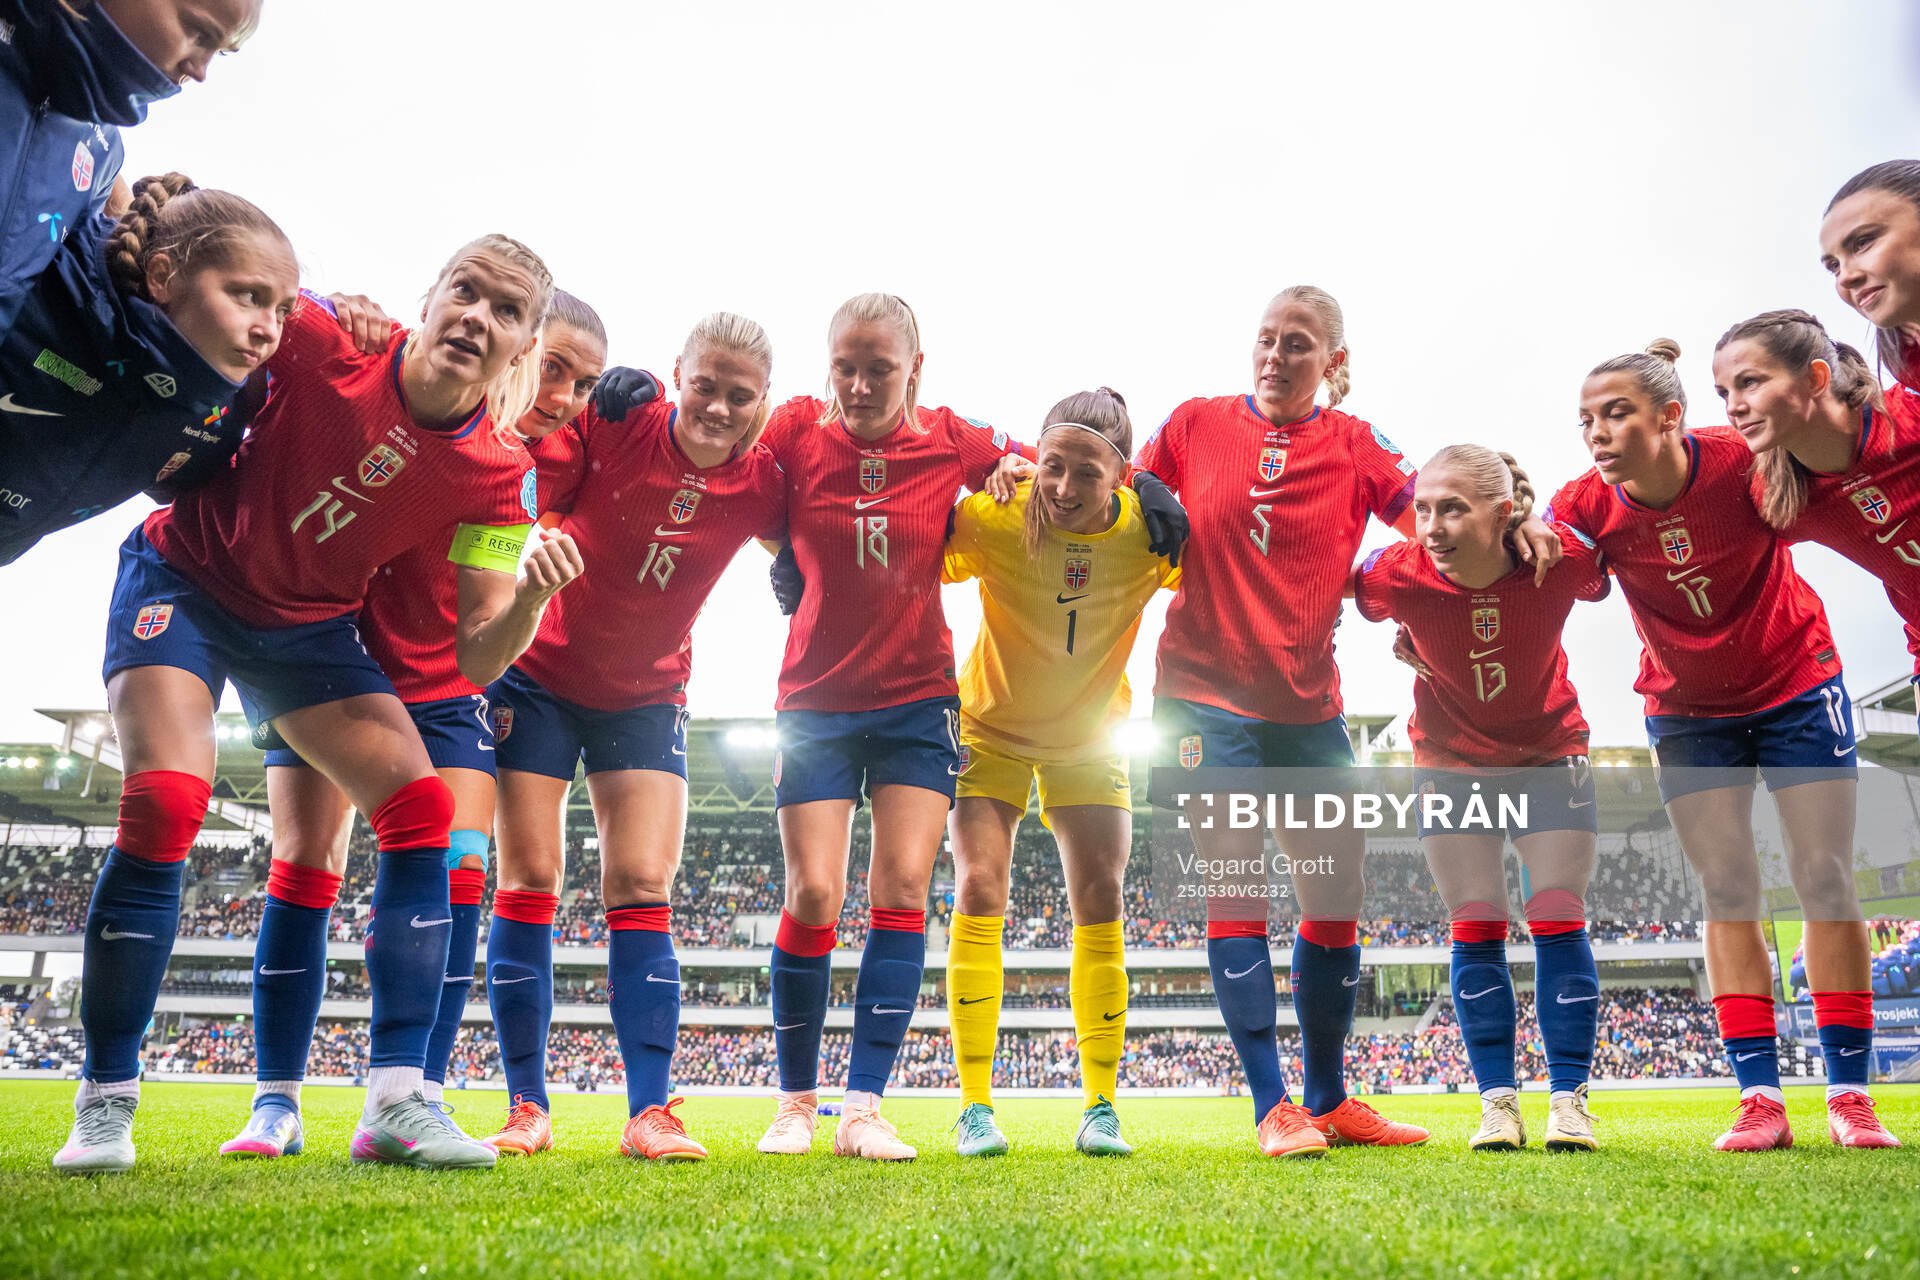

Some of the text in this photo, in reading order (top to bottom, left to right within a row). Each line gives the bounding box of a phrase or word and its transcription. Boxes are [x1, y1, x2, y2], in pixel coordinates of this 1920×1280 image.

[291, 491, 357, 544] 14
[1250, 504, 1272, 557] 5
[636, 542, 682, 592] 16
[854, 516, 888, 570] 18
[1676, 576, 1712, 618] 17
[1066, 610, 1077, 657] 1
[1471, 662, 1506, 703] 13
[1820, 686, 1847, 737] 17
